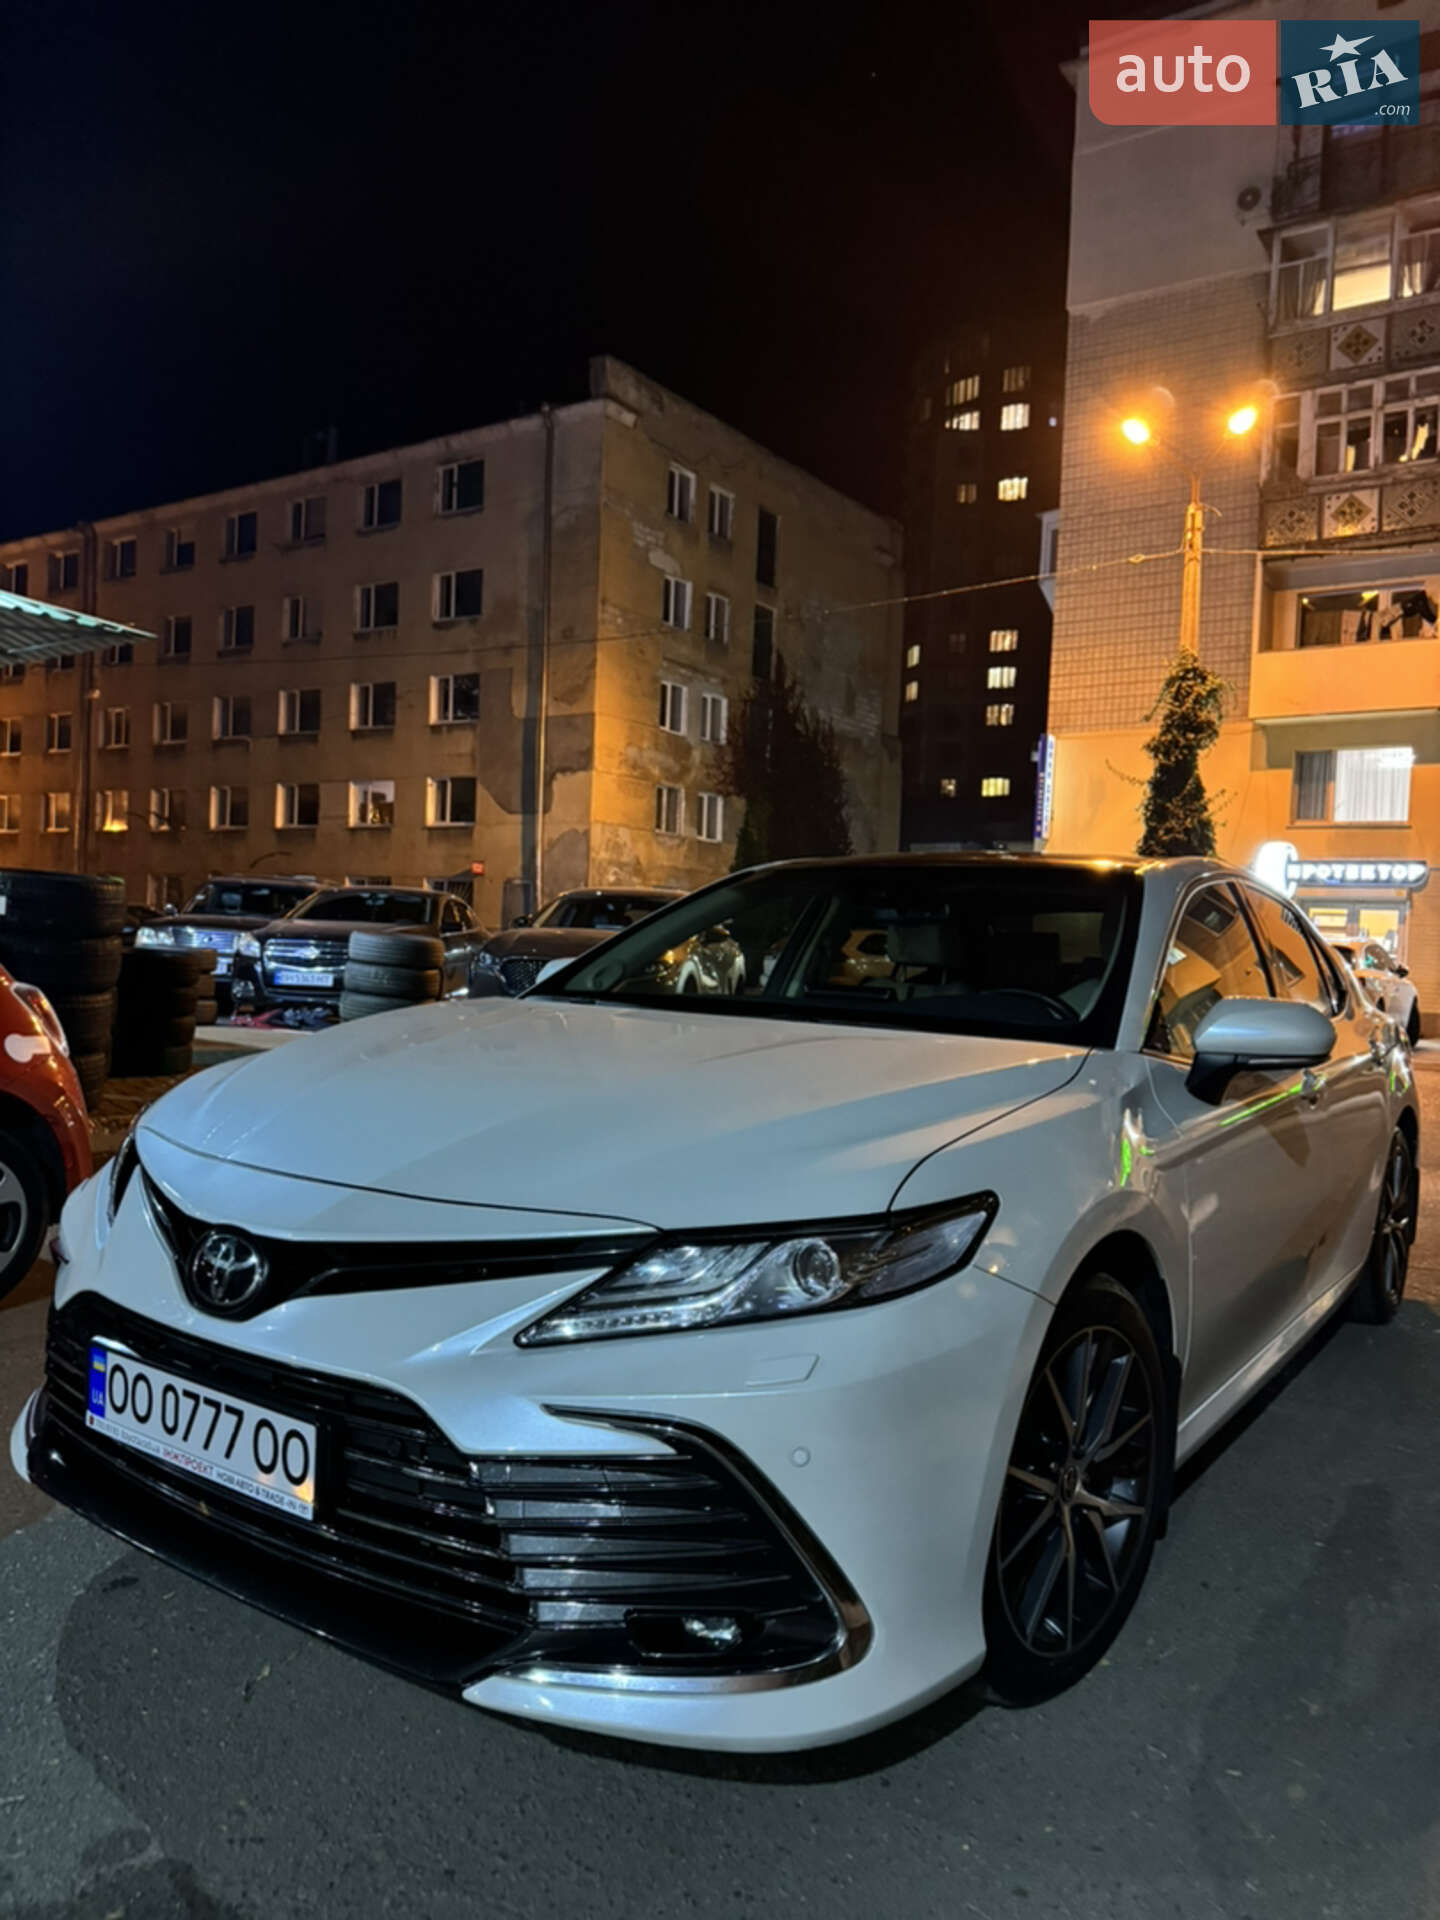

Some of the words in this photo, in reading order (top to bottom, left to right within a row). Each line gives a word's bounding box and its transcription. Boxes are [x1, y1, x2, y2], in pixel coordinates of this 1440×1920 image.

[91, 1388, 105, 1406] UA
[108, 1363, 153, 1425] OO
[160, 1383, 245, 1460] 0777
[252, 1417, 310, 1487] OO
